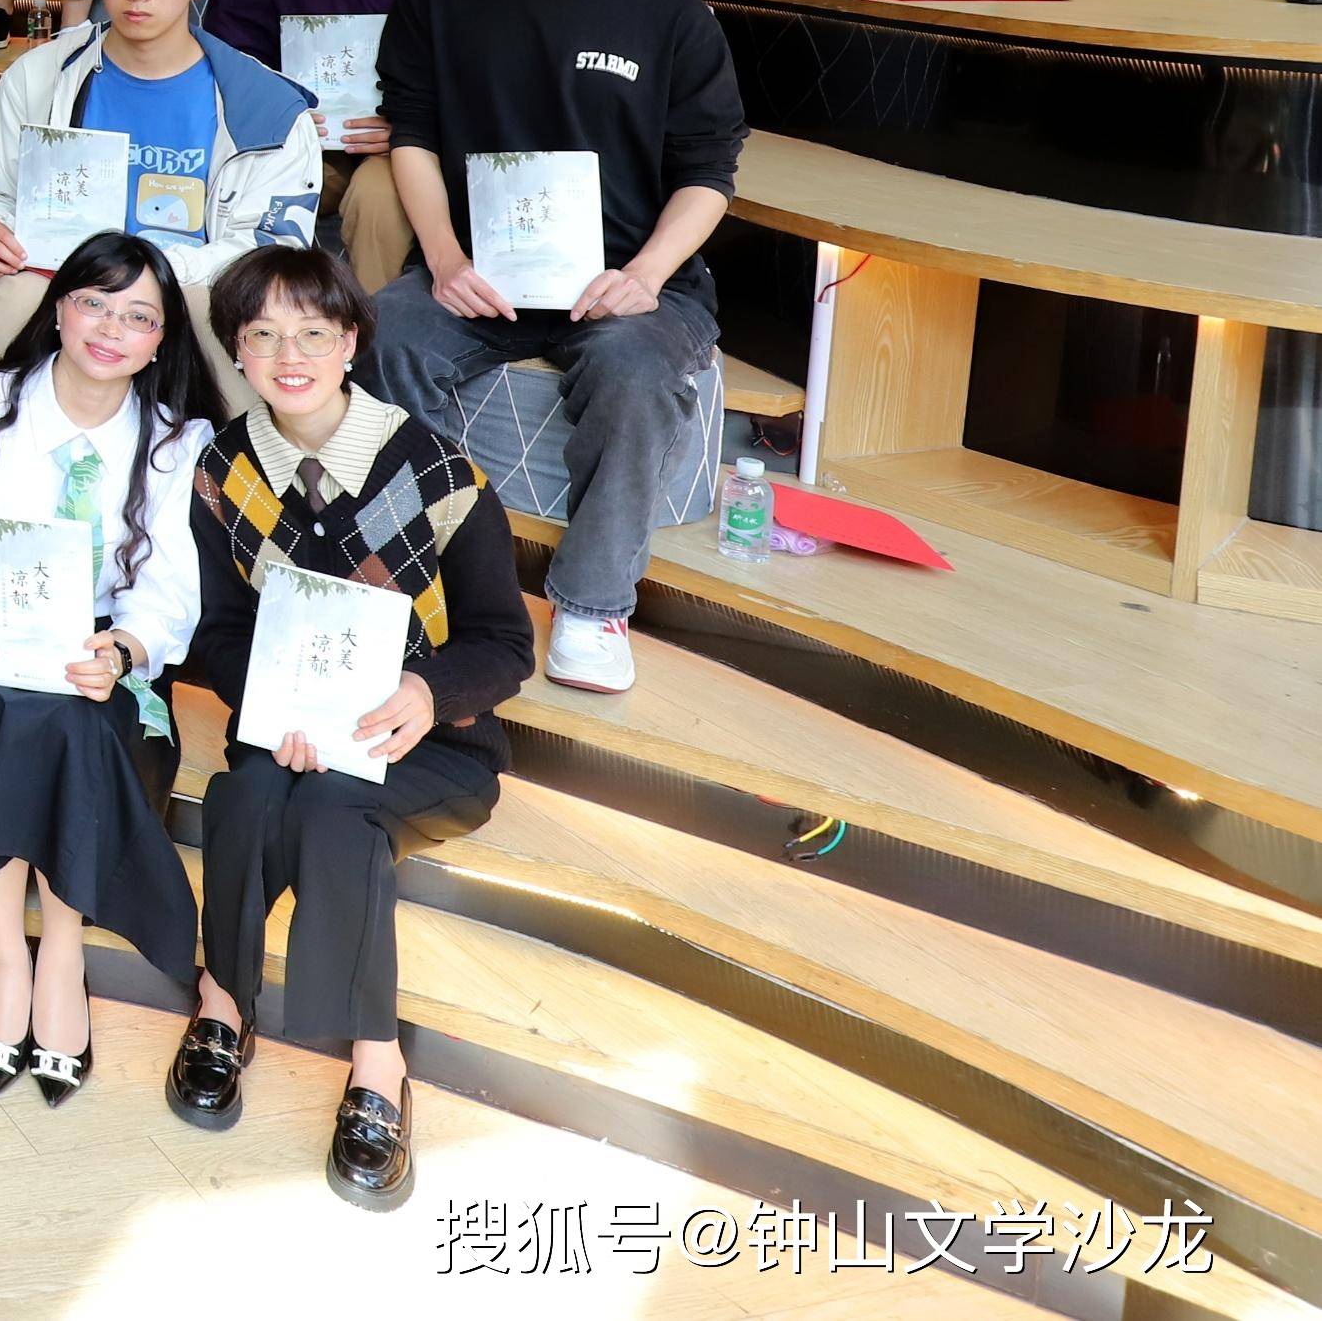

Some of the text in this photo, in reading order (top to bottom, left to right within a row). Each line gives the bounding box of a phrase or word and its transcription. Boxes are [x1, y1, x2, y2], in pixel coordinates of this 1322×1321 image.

[321, 53, 337, 86] 凉都
[340, 44, 356, 78] 大美
[75, 163, 89, 198] 大美
[538, 185, 556, 223] 大美
[33, 560, 50, 602] 大美
[339, 626, 359, 672] 大美
